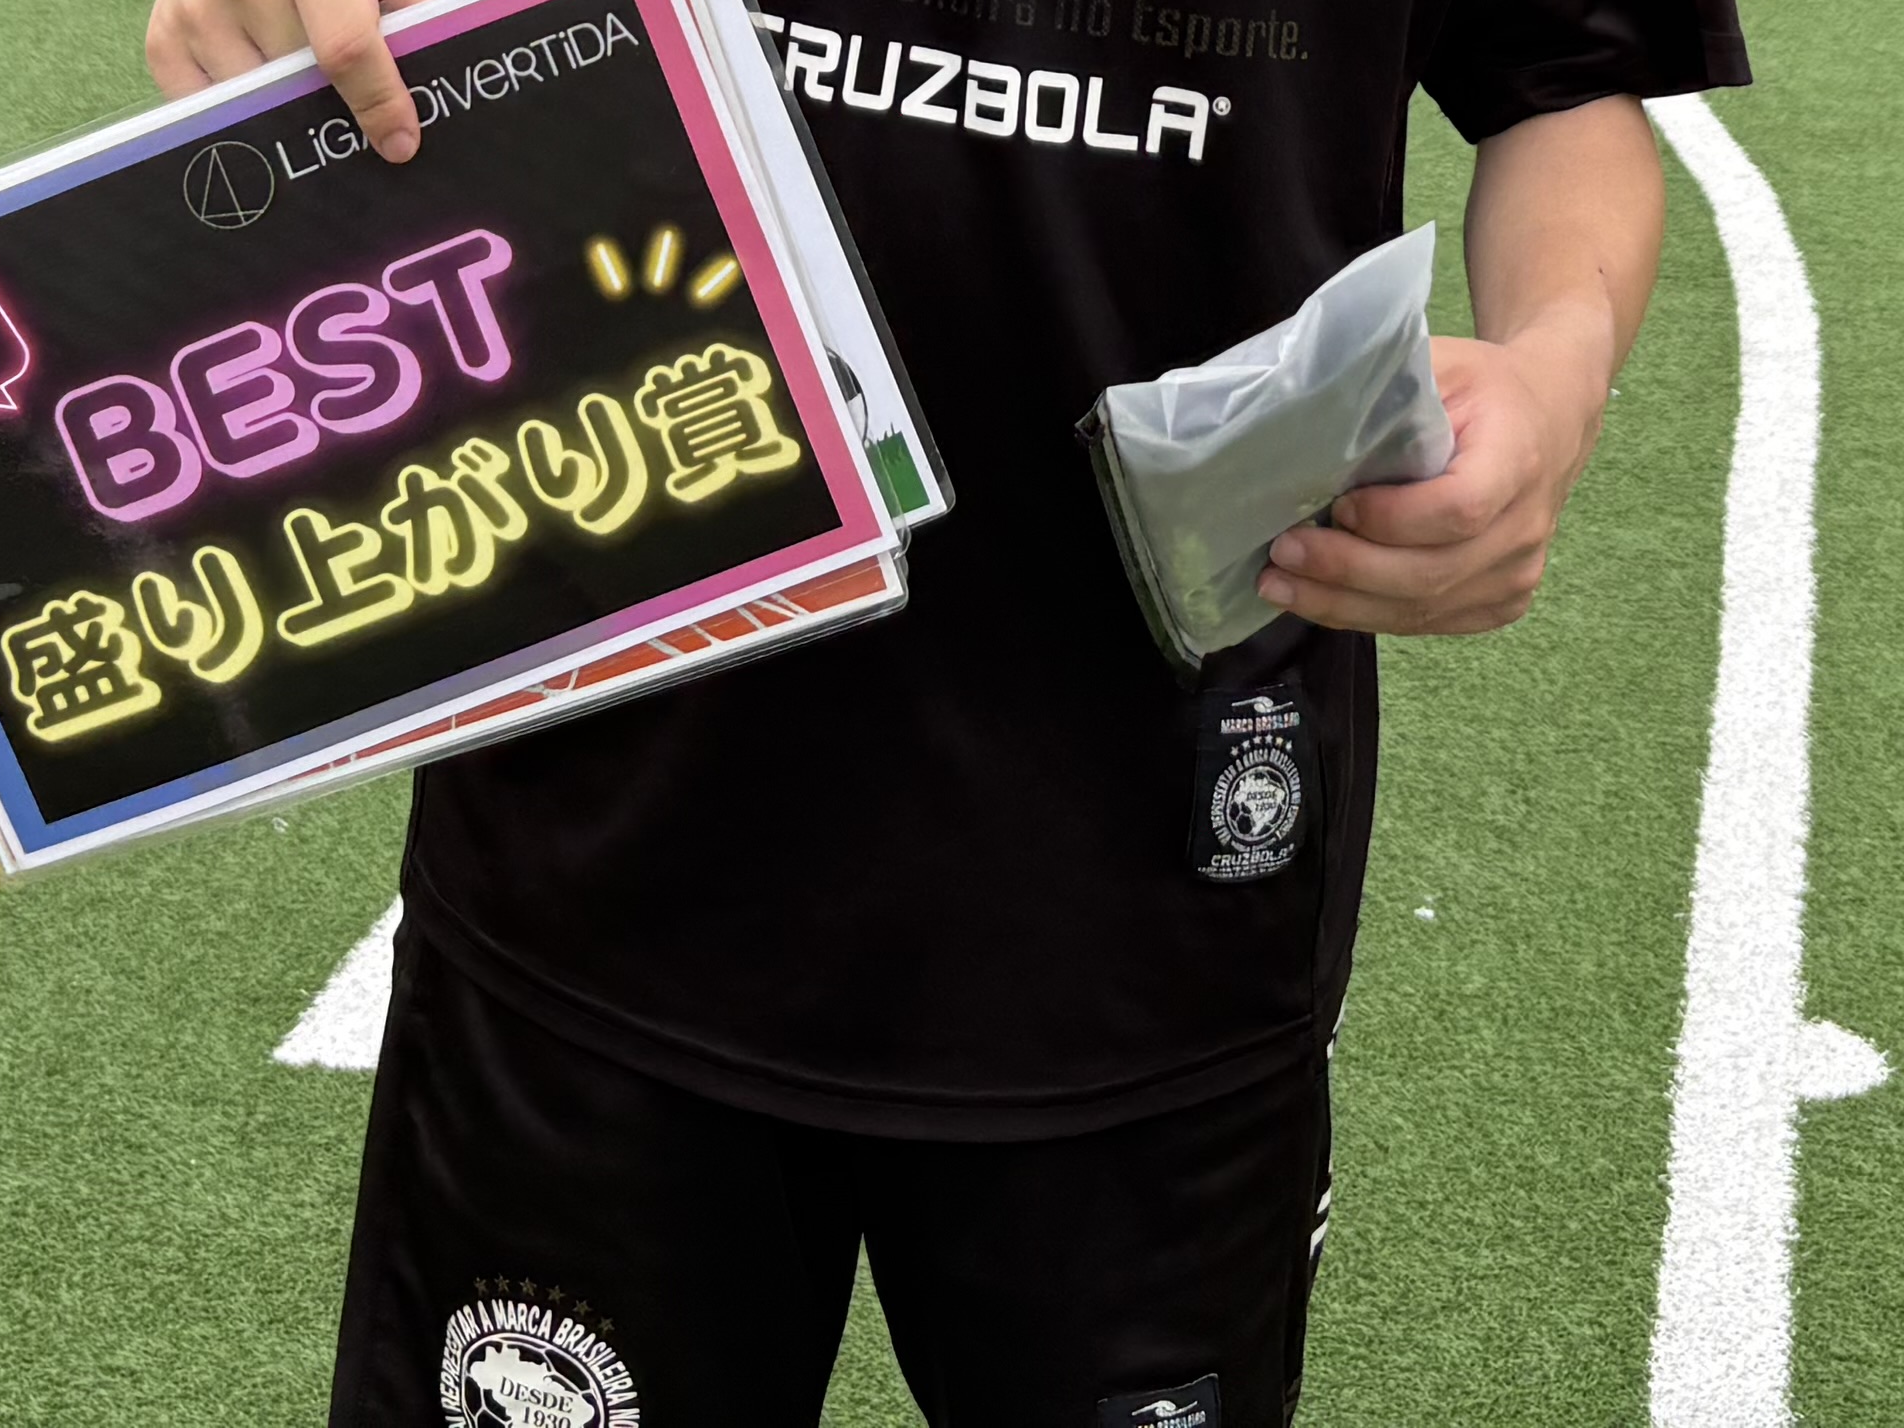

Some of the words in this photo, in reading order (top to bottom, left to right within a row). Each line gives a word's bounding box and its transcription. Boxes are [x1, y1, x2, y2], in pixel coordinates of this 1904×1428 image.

[54, 228, 514, 523] BEST
[0, 342, 801, 743] 盛り上がり賞
[477, 1299, 494, 1333] A
[492, 1299, 552, 1340] MARCA
[552, 1317, 638, 1406] BRASILEIRA
[500, 1376, 574, 1414] DESDE
